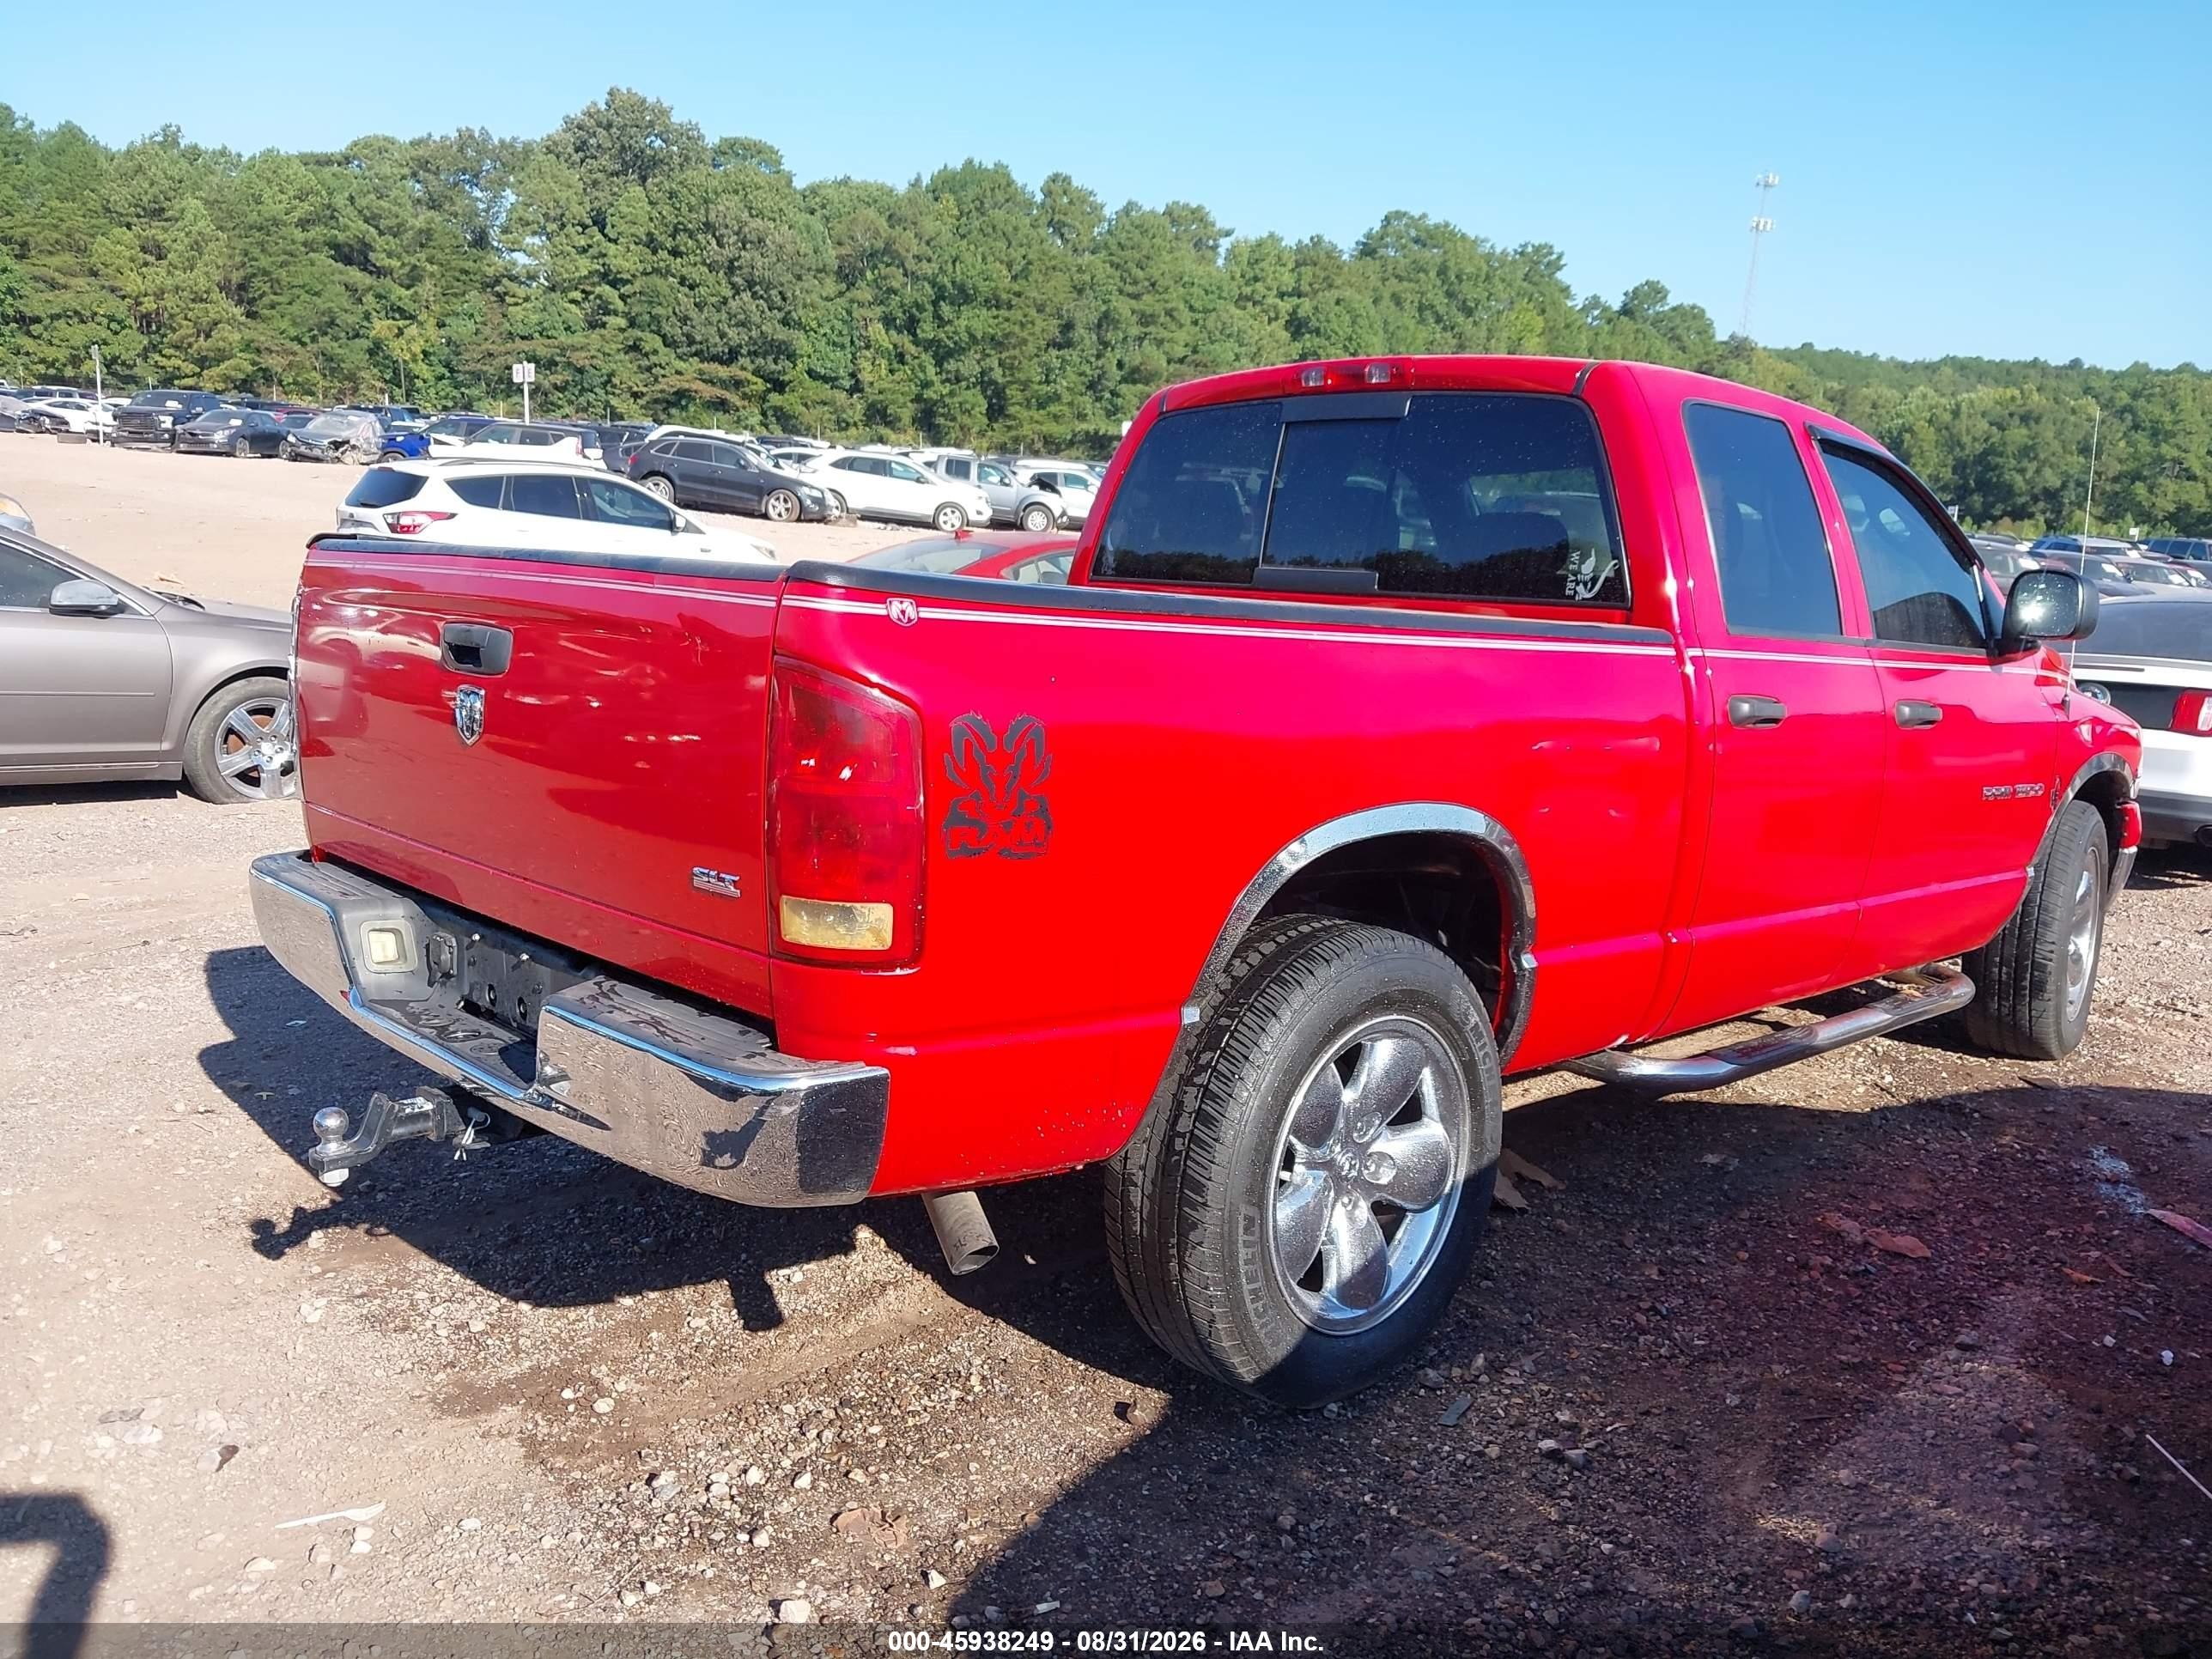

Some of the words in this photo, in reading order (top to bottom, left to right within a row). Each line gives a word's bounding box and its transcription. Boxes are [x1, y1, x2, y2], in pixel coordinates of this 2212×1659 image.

[1570, 550, 1581, 570] WE
[1566, 574, 1577, 596] ARE
[692, 866, 740, 893] SLT
[1242, 1211, 1279, 1345] ICHELIN
